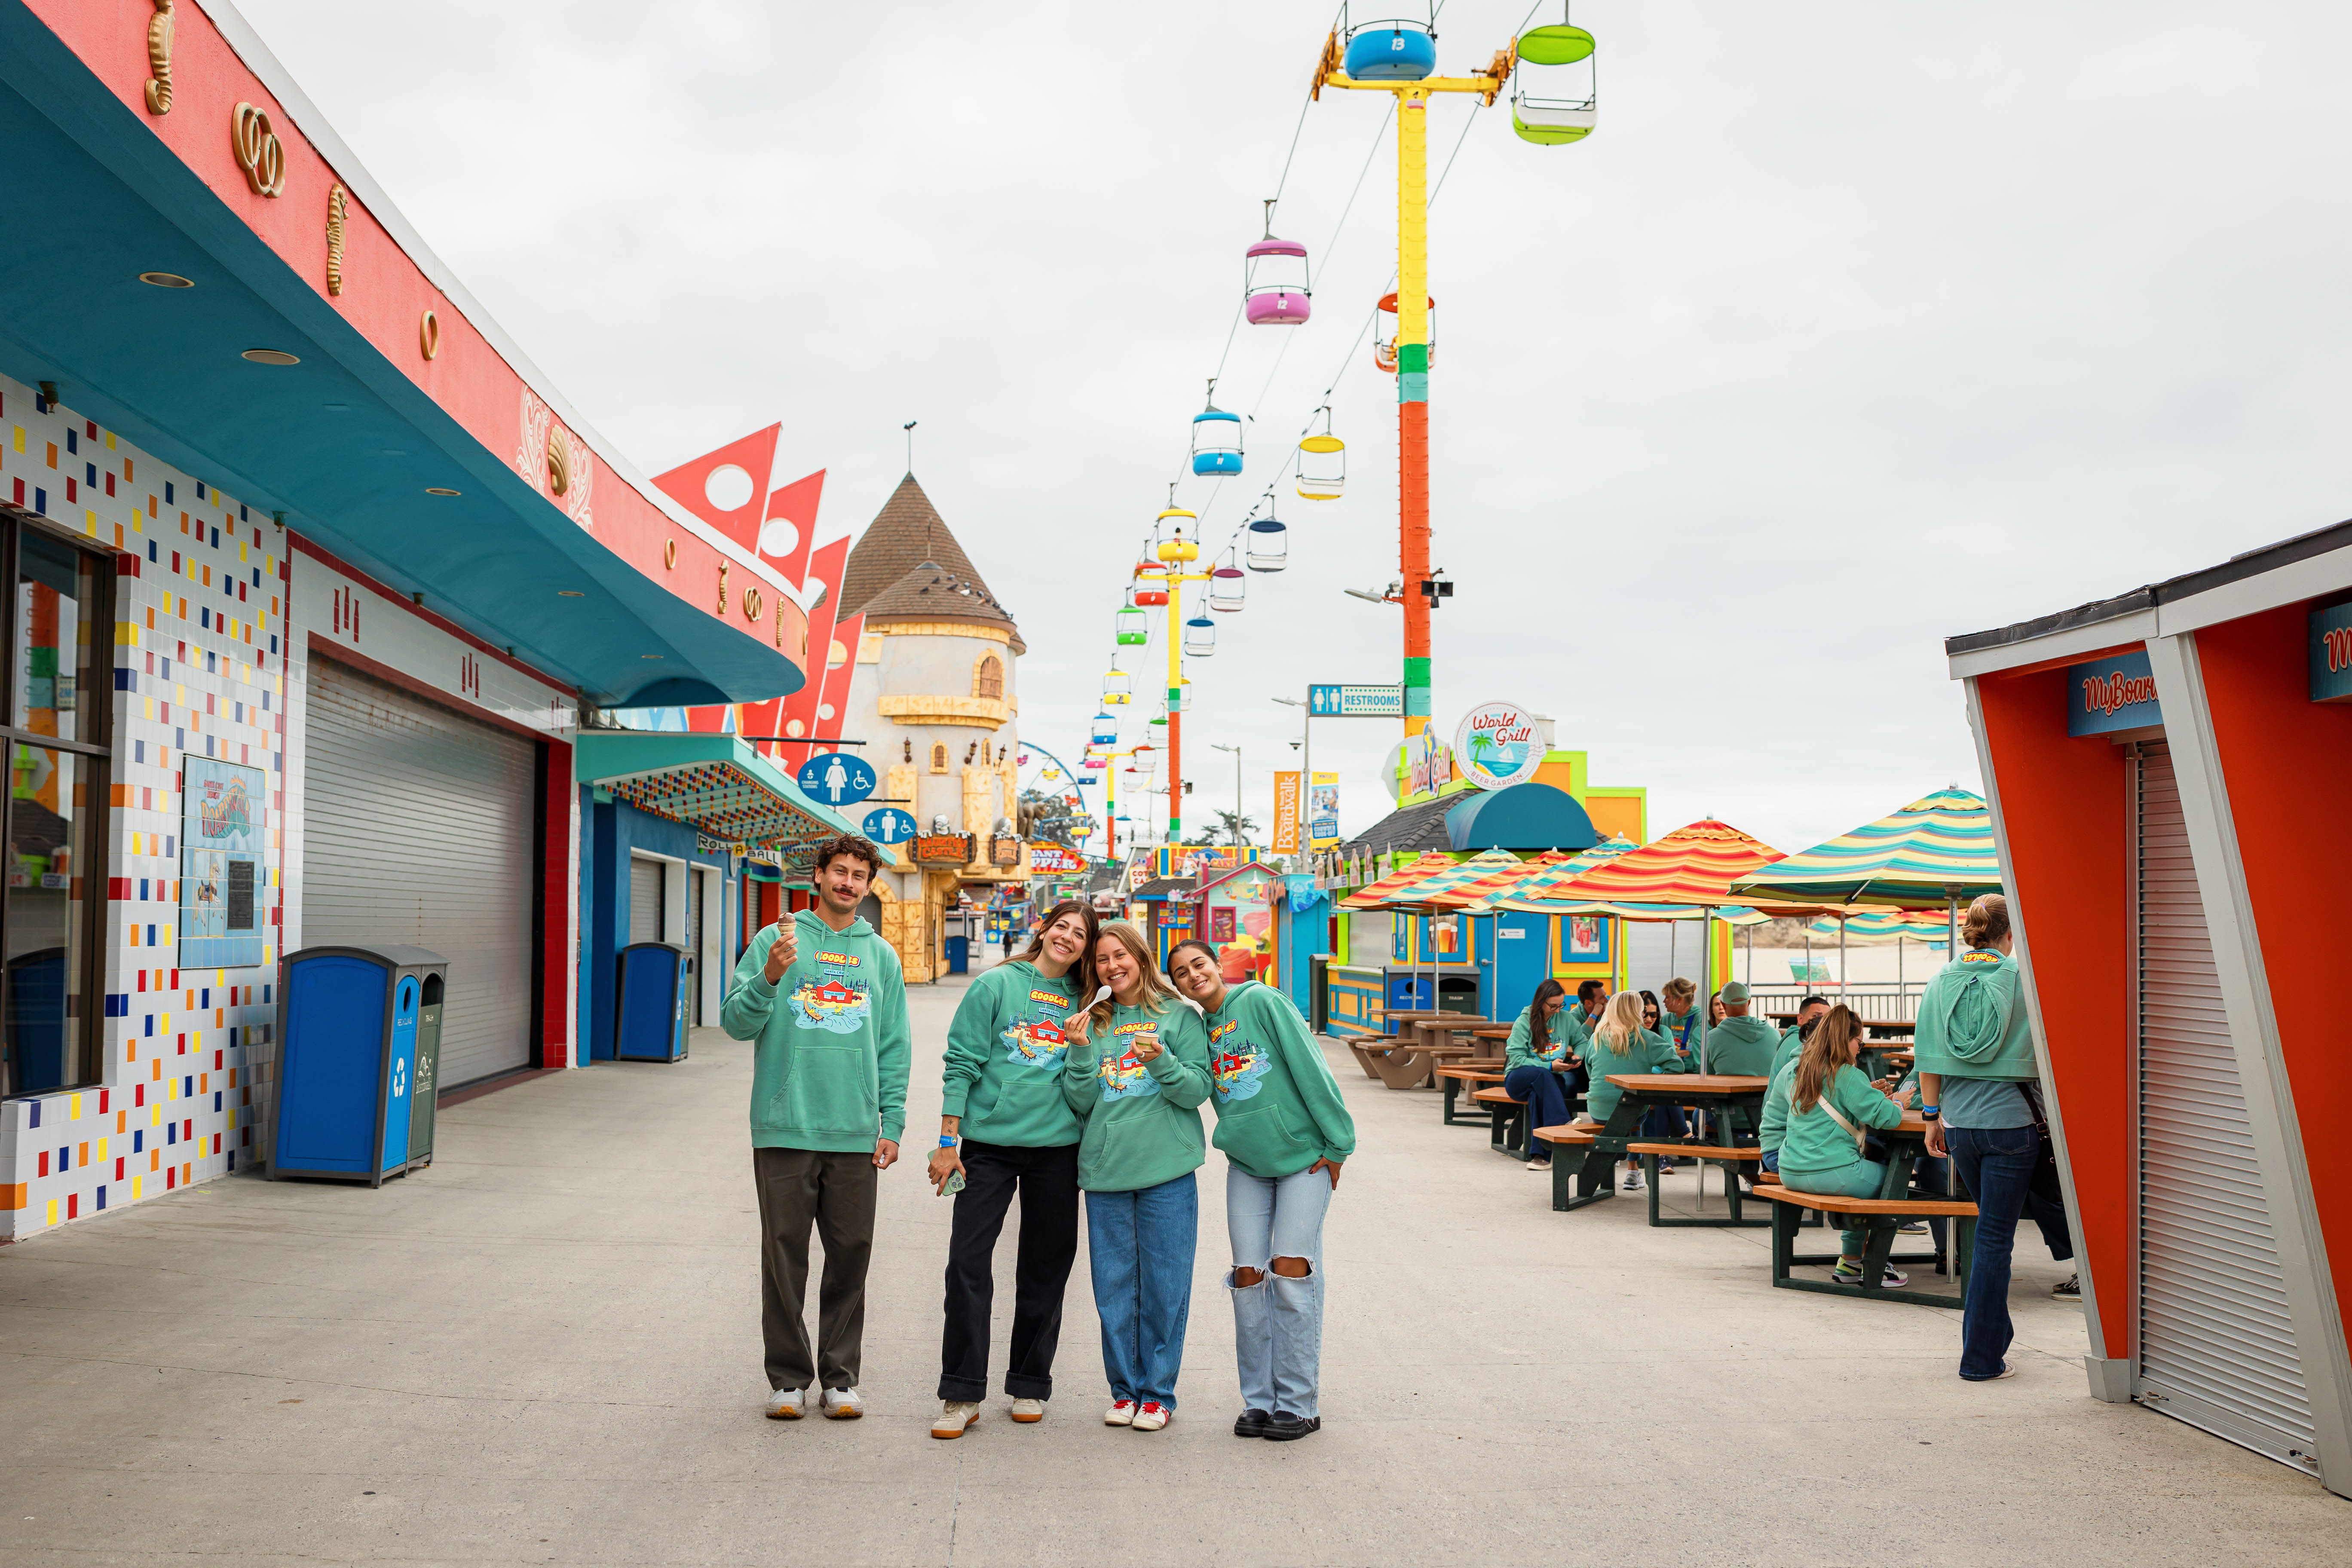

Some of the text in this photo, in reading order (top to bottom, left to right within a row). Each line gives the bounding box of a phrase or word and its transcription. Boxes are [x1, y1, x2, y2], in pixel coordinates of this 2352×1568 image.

[1391, 37, 1405, 51] 13
[1277, 300, 1288, 309] 12
[1344, 695, 1400, 705] RESTROOMS
[1473, 713, 1516, 730] World
[1496, 728, 1531, 745] Grill
[1471, 772, 1522, 786] BEER GARDEN
[201, 787, 250, 837] BOARDWALK
[1277, 775, 1295, 850] Boardwalk
[698, 835, 778, 864] ROLL A BALL
[918, 837, 967, 848] HAUNTED
[922, 847, 964, 858] CASTLE
[1032, 849, 1063, 858] IANT
[1032, 858, 1077, 870] PPER
[1031, 990, 1068, 1007] GOODLES
[1211, 1020, 1236, 1042] GOODES
